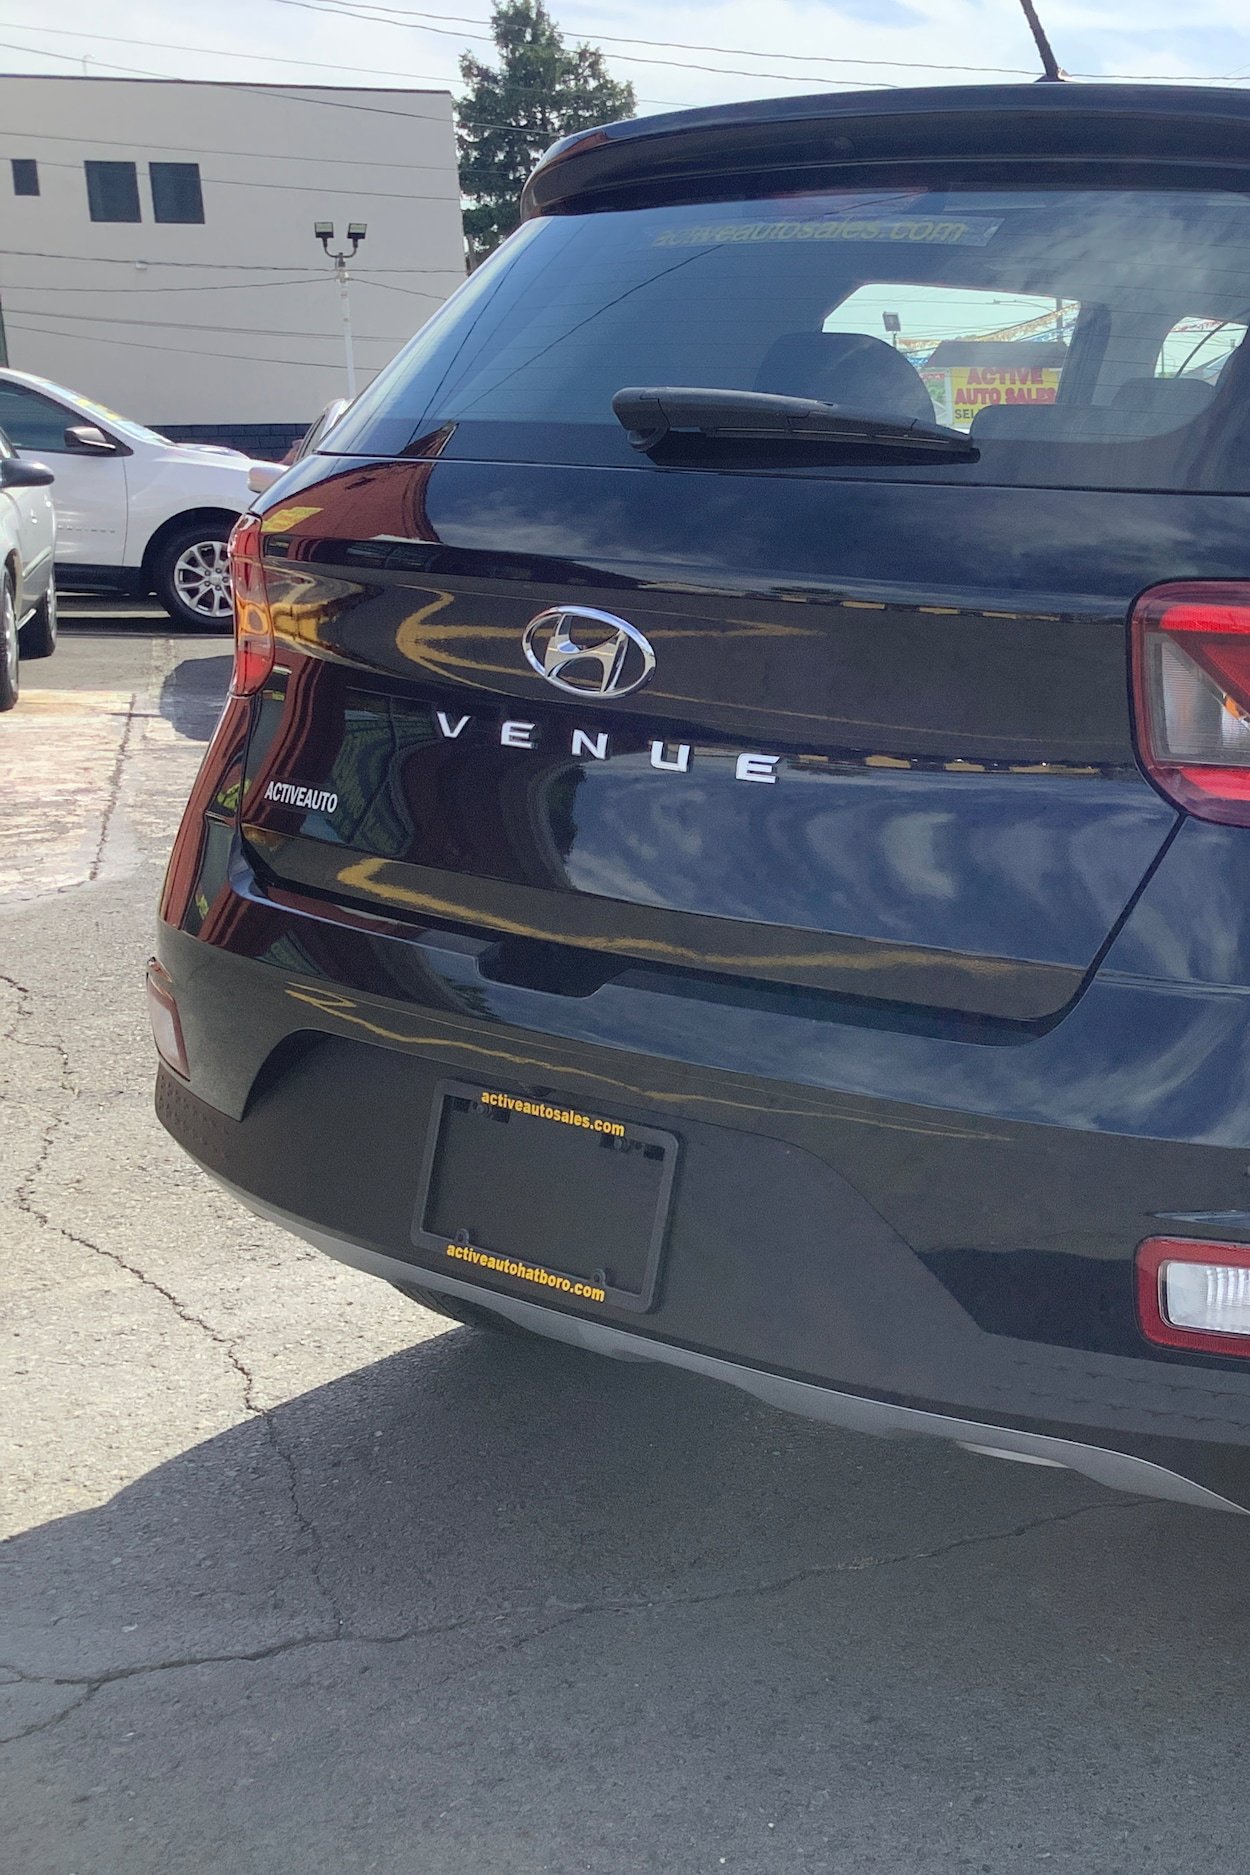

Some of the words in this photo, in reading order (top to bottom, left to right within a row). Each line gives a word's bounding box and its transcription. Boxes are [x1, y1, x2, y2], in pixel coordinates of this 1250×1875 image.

[654, 219, 968, 247] activeautosales.com
[967, 367, 1044, 385] ACTIVE
[954, 388, 1001, 405] AUTO
[1005, 388, 1057, 404] SALES
[436, 711, 780, 784] VENUE
[264, 781, 338, 814] ACTIVEAUTO
[481, 1091, 625, 1137] activeautosales.com
[446, 1244, 606, 1302] activeautohatboro.com
